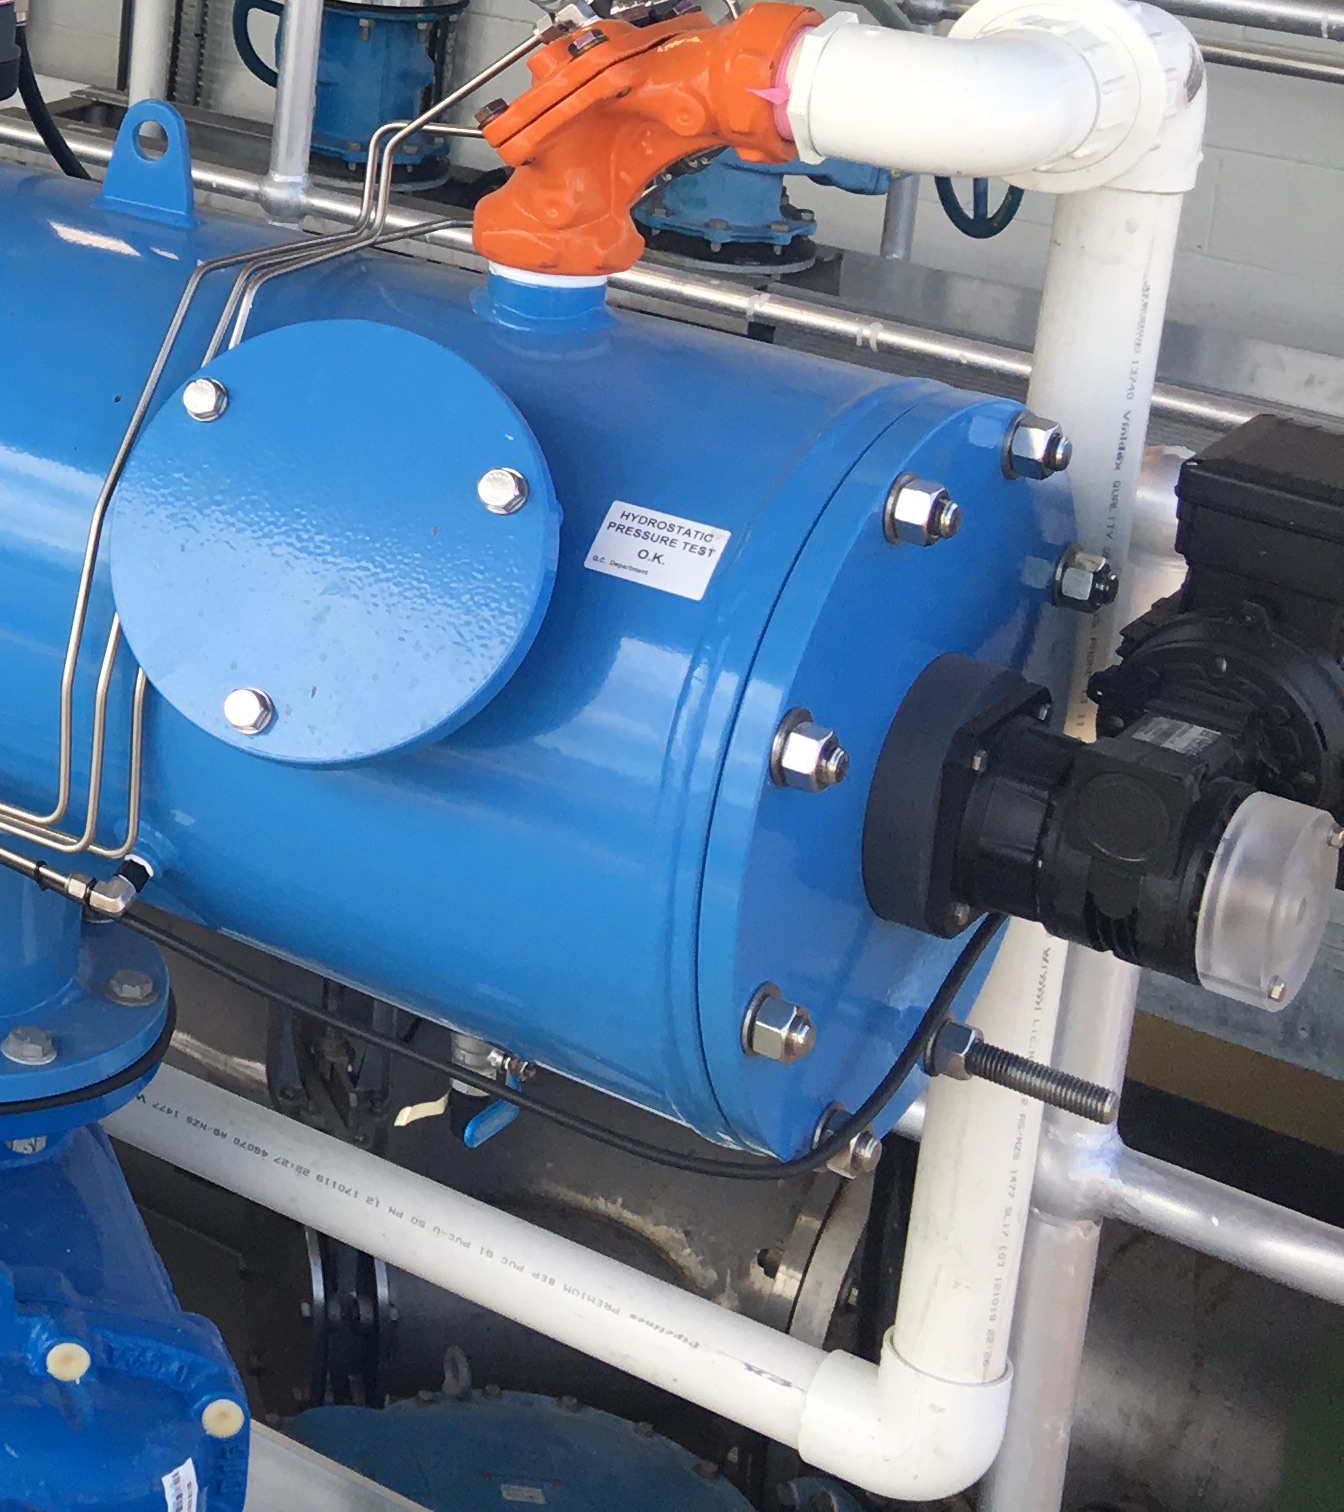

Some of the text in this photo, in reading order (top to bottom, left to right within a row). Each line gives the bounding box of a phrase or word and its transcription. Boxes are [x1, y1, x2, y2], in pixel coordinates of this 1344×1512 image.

[1113, 409, 1132, 470] Vinidex
[1105, 480, 1122, 539] QUALITY
[620, 510, 714, 543] HYDROSTATIC
[607, 521, 716, 558] PRESSURE TEST
[609, 559, 649, 576] Department
[637, 549, 665, 566] O.K.
[152, 1102, 180, 1118] 1477
[316, 1175, 359, 1198] 170119
[365, 1196, 380, 1208] 12
[388, 1206, 404, 1219] PN
[501, 1257, 525, 1272] PVC
[563, 1284, 620, 1315] PREMIUM
